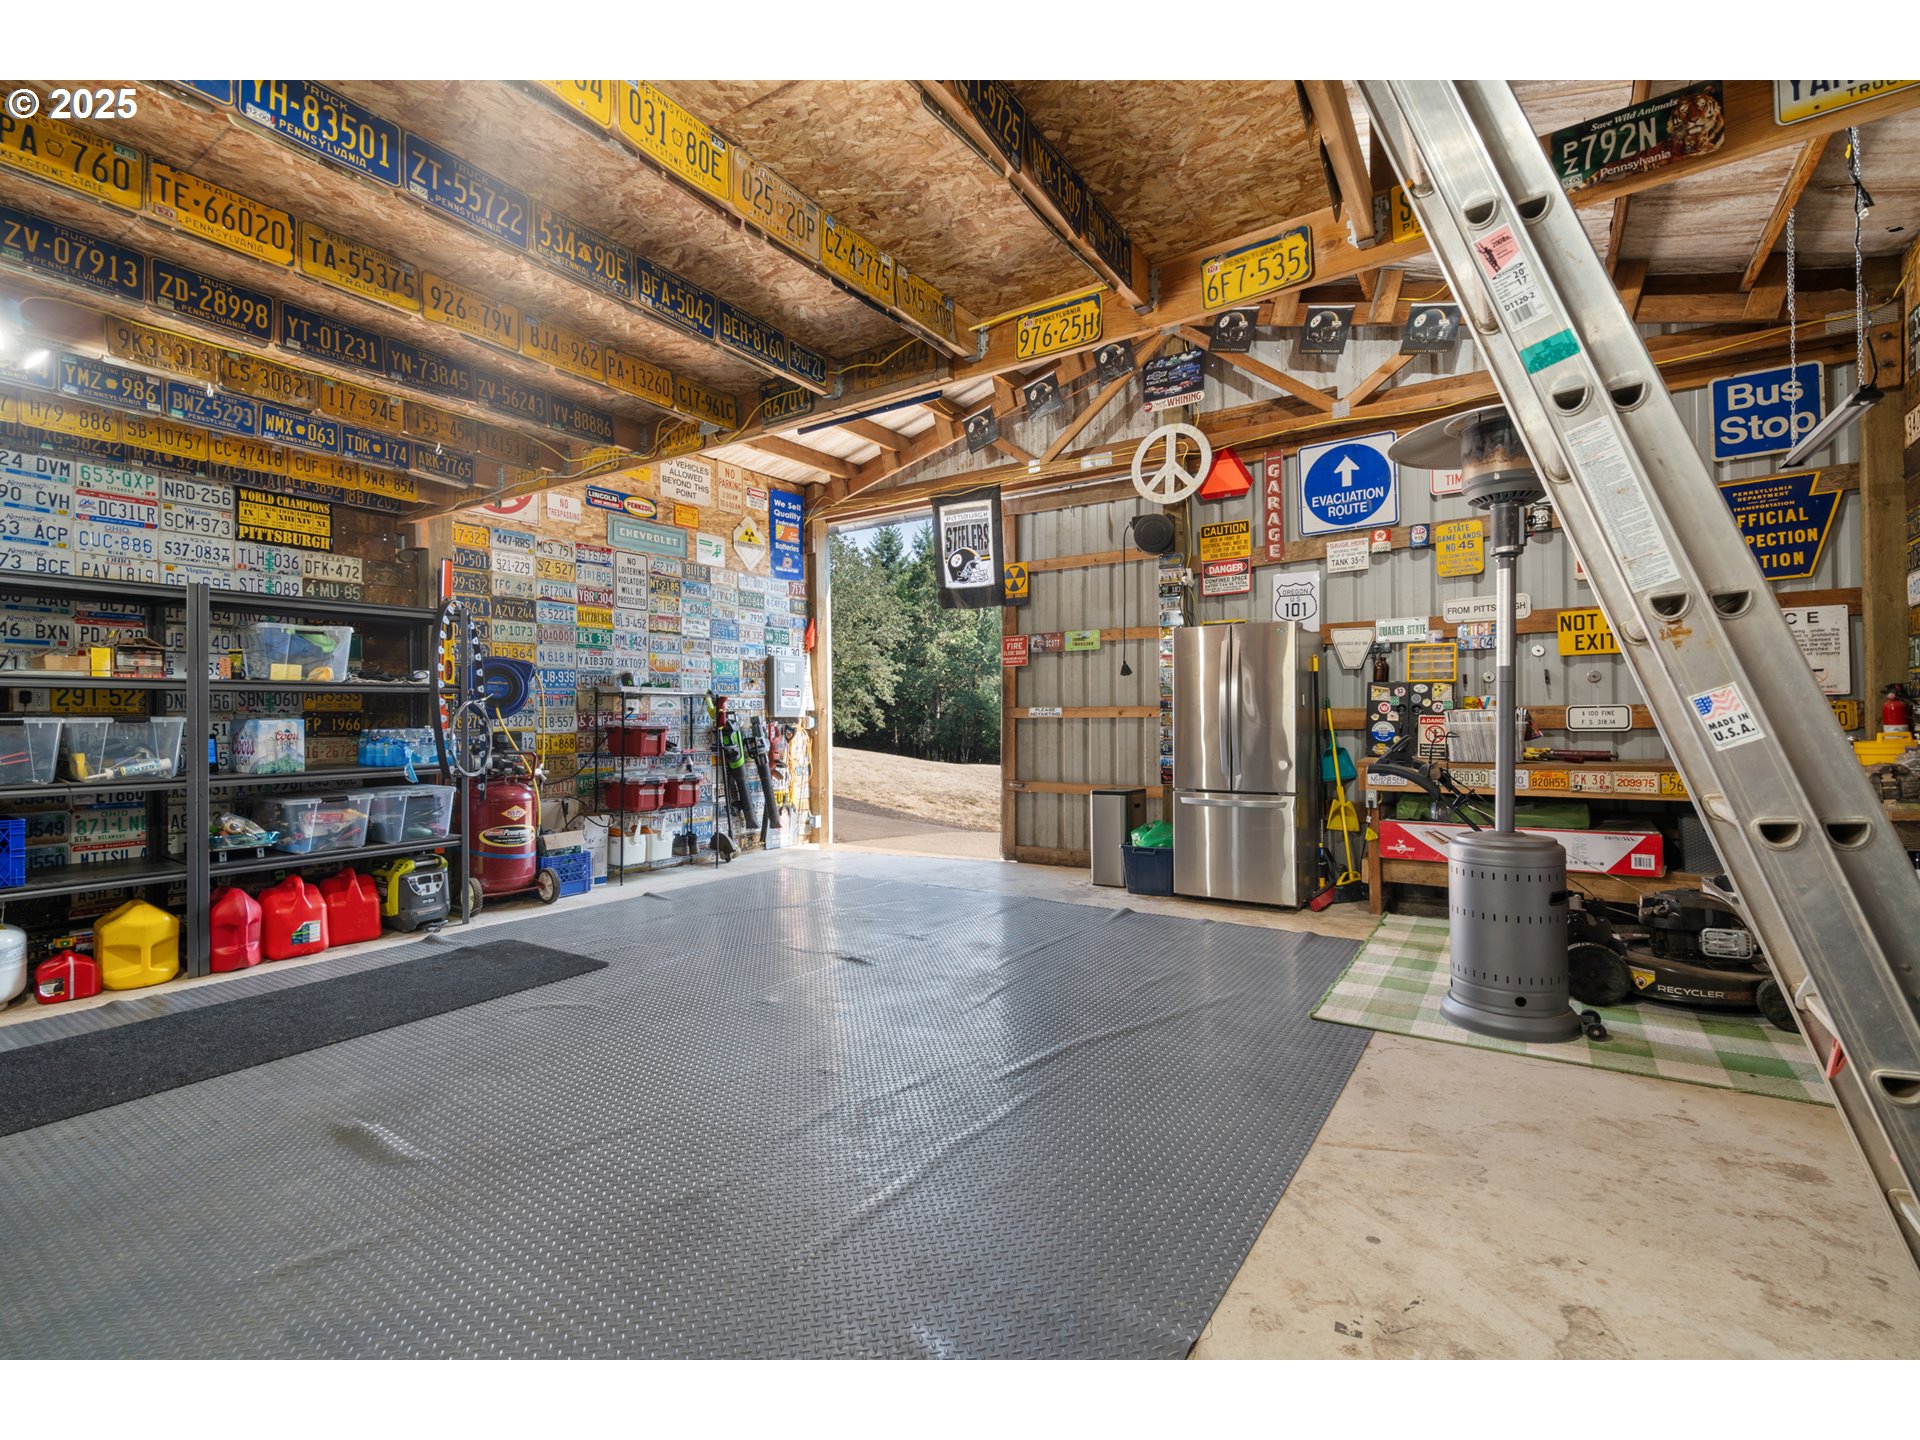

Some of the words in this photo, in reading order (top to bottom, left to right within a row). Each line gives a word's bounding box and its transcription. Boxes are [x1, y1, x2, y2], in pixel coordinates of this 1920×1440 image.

[302, 81, 349, 112] TRUCK
[644, 86, 709, 139] PENNSYLVANIA
[1591, 120, 1611, 132] Save
[1613, 111, 1630, 125] Wild
[1632, 98, 1678, 120] Animals
[279, 118, 367, 168] PENNSYLVANIA
[629, 88, 667, 147] 031
[686, 131, 722, 182] 80E
[1583, 116, 1658, 169] 792N
[71, 140, 129, 191] 760
[644, 137, 684, 170] KEYSTONE
[685, 163, 707, 181] STATE
[1600, 150, 1672, 178] Pennsylvania
[71, 174, 104, 195] STATE
[412, 150, 523, 235] ZT-55722
[193, 179, 257, 210] TRAILER
[435, 194, 501, 233] PENNSYLVANIA
[742, 170, 774, 216] 025
[787, 201, 815, 243] 20P
[53, 226, 96, 246] TRUCK
[185, 216, 265, 255] PENNSYLVANIA
[3, 219, 138, 288] ZV-07913
[540, 221, 580, 261] 534
[594, 248, 627, 285] 90E
[1223, 242, 1284, 267] PENNSYLVANIA
[33, 255, 115, 290] PENNSYLVANIA
[337, 273, 390, 299] TRAILER
[160, 273, 269, 330] ZD-28998
[431, 285, 466, 319] 926
[480, 303, 512, 337] 79V
[288, 318, 378, 365] YT-01231
[571, 341, 598, 371] 962
[64, 363, 102, 390] YMZ
[122, 378, 157, 403] 986
[1167, 391, 1202, 407] WHINING
[1727, 380, 1804, 411] Bus
[79, 411, 111, 433] 886
[265, 413, 294, 436] WMX
[307, 423, 335, 446] 063
[1720, 411, 1817, 445] Stop
[346, 433, 371, 455] TDK
[384, 442, 407, 464] 174
[36, 457, 71, 478] DVM
[295, 457, 318, 474] CUF
[330, 463, 352, 482] 143
[669, 467, 704, 483] ALLOWED
[675, 460, 710, 476] VEHICLES
[725, 468, 735, 479] NO
[164, 481, 231, 506] NRD-256
[393, 476, 415, 495] 854
[662, 475, 692, 489] BEYOND
[694, 484, 710, 494] THIS
[719, 478, 742, 492] PARKING
[1732, 484, 1793, 498] PENNSYLVANIA
[36, 490, 70, 509] CVH
[239, 489, 275, 504] WORLD
[276, 495, 330, 514] CHAMPIONS
[588, 490, 618, 503] LINCOLN
[676, 489, 697, 500] POINT
[1311, 486, 1384, 508] EVACUATION
[1737, 490, 1790, 503] DEPARTMENT
[98, 500, 155, 523] DC31LR
[184, 507, 212, 517] Virginia
[560, 499, 569, 509] NO
[626, 501, 654, 513] PENNZOIL
[773, 499, 786, 508] We
[788, 502, 801, 511] Sell
[1266, 463, 1282, 558] GARAGE
[1327, 501, 1368, 518] ROUTE
[1733, 500, 1795, 512] TRANSPORTATION
[549, 508, 581, 521] TRESPASSING
[773, 509, 801, 522] Quality
[946, 511, 988, 522] PITTSBURGH
[1737, 507, 1809, 529] FFICIAL
[34, 524, 68, 541] ACP
[164, 512, 230, 536] SCM-973
[1203, 523, 1247, 536] CAUTION
[1447, 524, 1470, 533] STATE
[239, 525, 331, 549] PITTSBURGH
[619, 527, 678, 547] CHEVROLET
[945, 523, 990, 551] STEELERS
[1437, 534, 1456, 543] GAME
[1458, 531, 1482, 540] LANDS
[1445, 543, 1456, 552] NO
[1459, 540, 1474, 549] 45
[537, 540, 553, 554] MCS
[558, 544, 574, 558] 751
[239, 548, 265, 565] TLH
[274, 552, 299, 569] 036
[320, 554, 346, 564] TEXAS
[627, 557, 636, 566] NO
[1331, 559, 1349, 567] TANK
[1351, 556, 1365, 564] 35-7
[618, 566, 645, 577] LOITERING
[1208, 563, 1243, 575] DANGER
[274, 580, 300, 597] 089
[618, 575, 646, 587] VIOLATORS
[540, 585, 573, 598] ARIZONA
[598, 592, 613, 605] 304
[622, 587, 632, 596] WILL
[634, 588, 642, 596] BE
[617, 596, 646, 607] PROSECUTED
[1284, 602, 1307, 617] 101
[1447, 606, 1470, 615] FROM
[35, 624, 69, 640] BXN
[1378, 626, 1406, 637] QUAKER
[1407, 624, 1427, 635] STATE
[1560, 614, 1597, 632] NOT
[633, 636, 647, 647] 424
[1007, 642, 1023, 650] FIRE
[1045, 640, 1060, 648] SCOTT
[1575, 634, 1614, 651] EXIT
[548, 651, 564, 662] 618
[331, 718, 360, 731] 1966
[1709, 718, 1735, 731] MADE
[1738, 712, 1750, 721] IN
[1714, 726, 1755, 742] U.S.A.
[1573, 774, 1587, 785] CK
[1592, 774, 1605, 784] 38
[1616, 778, 1656, 788] 209975
[1657, 984, 1726, 999] RECYCLER
